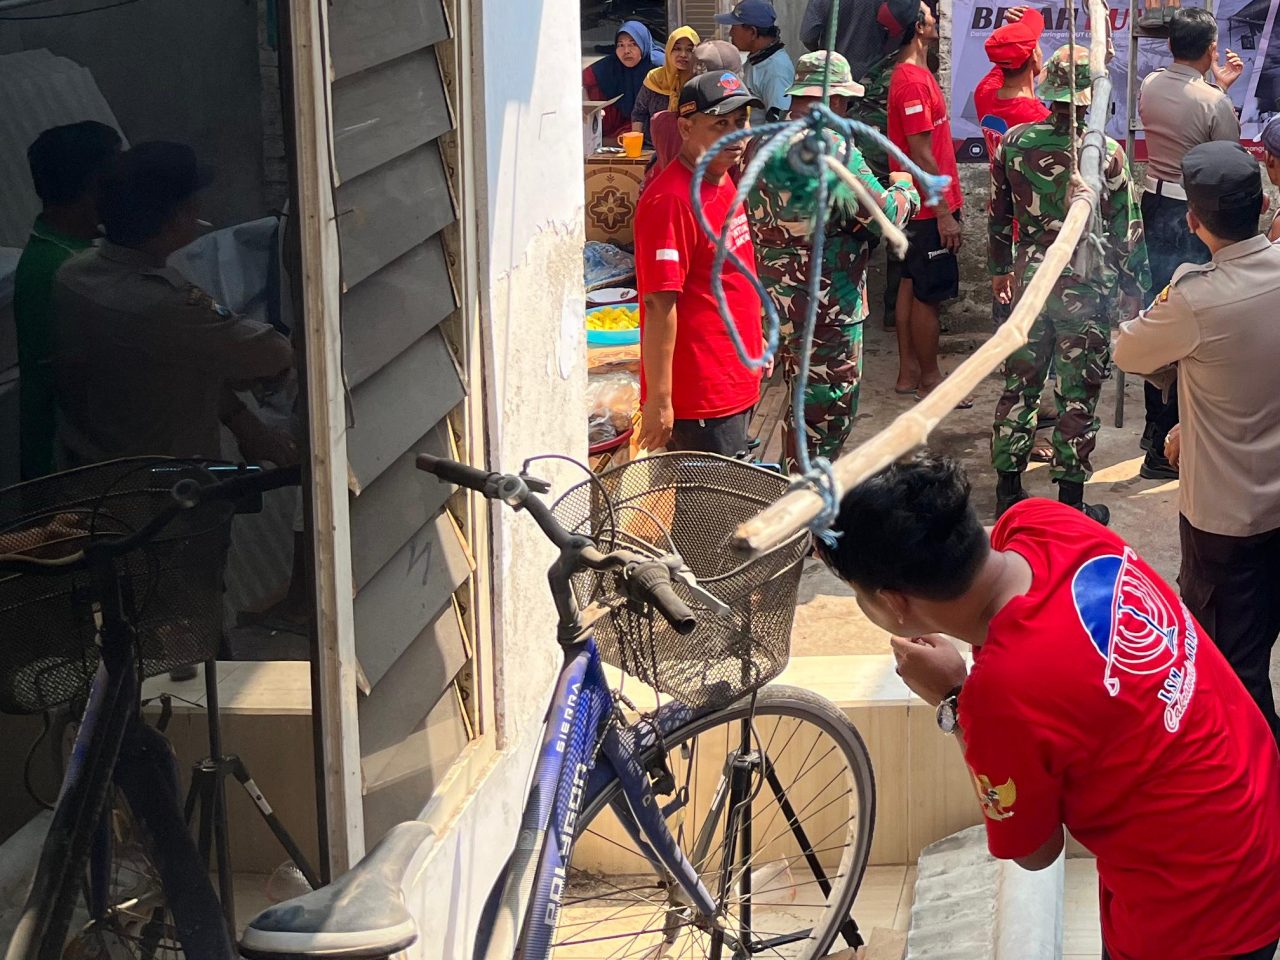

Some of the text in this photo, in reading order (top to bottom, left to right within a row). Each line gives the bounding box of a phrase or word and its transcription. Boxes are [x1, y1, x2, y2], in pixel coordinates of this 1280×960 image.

[971, 6, 1079, 30] BEAH
[1157, 666, 1183, 704] LSM
[556, 683, 581, 753] SIERRA
[544, 763, 588, 926] POLYGON
